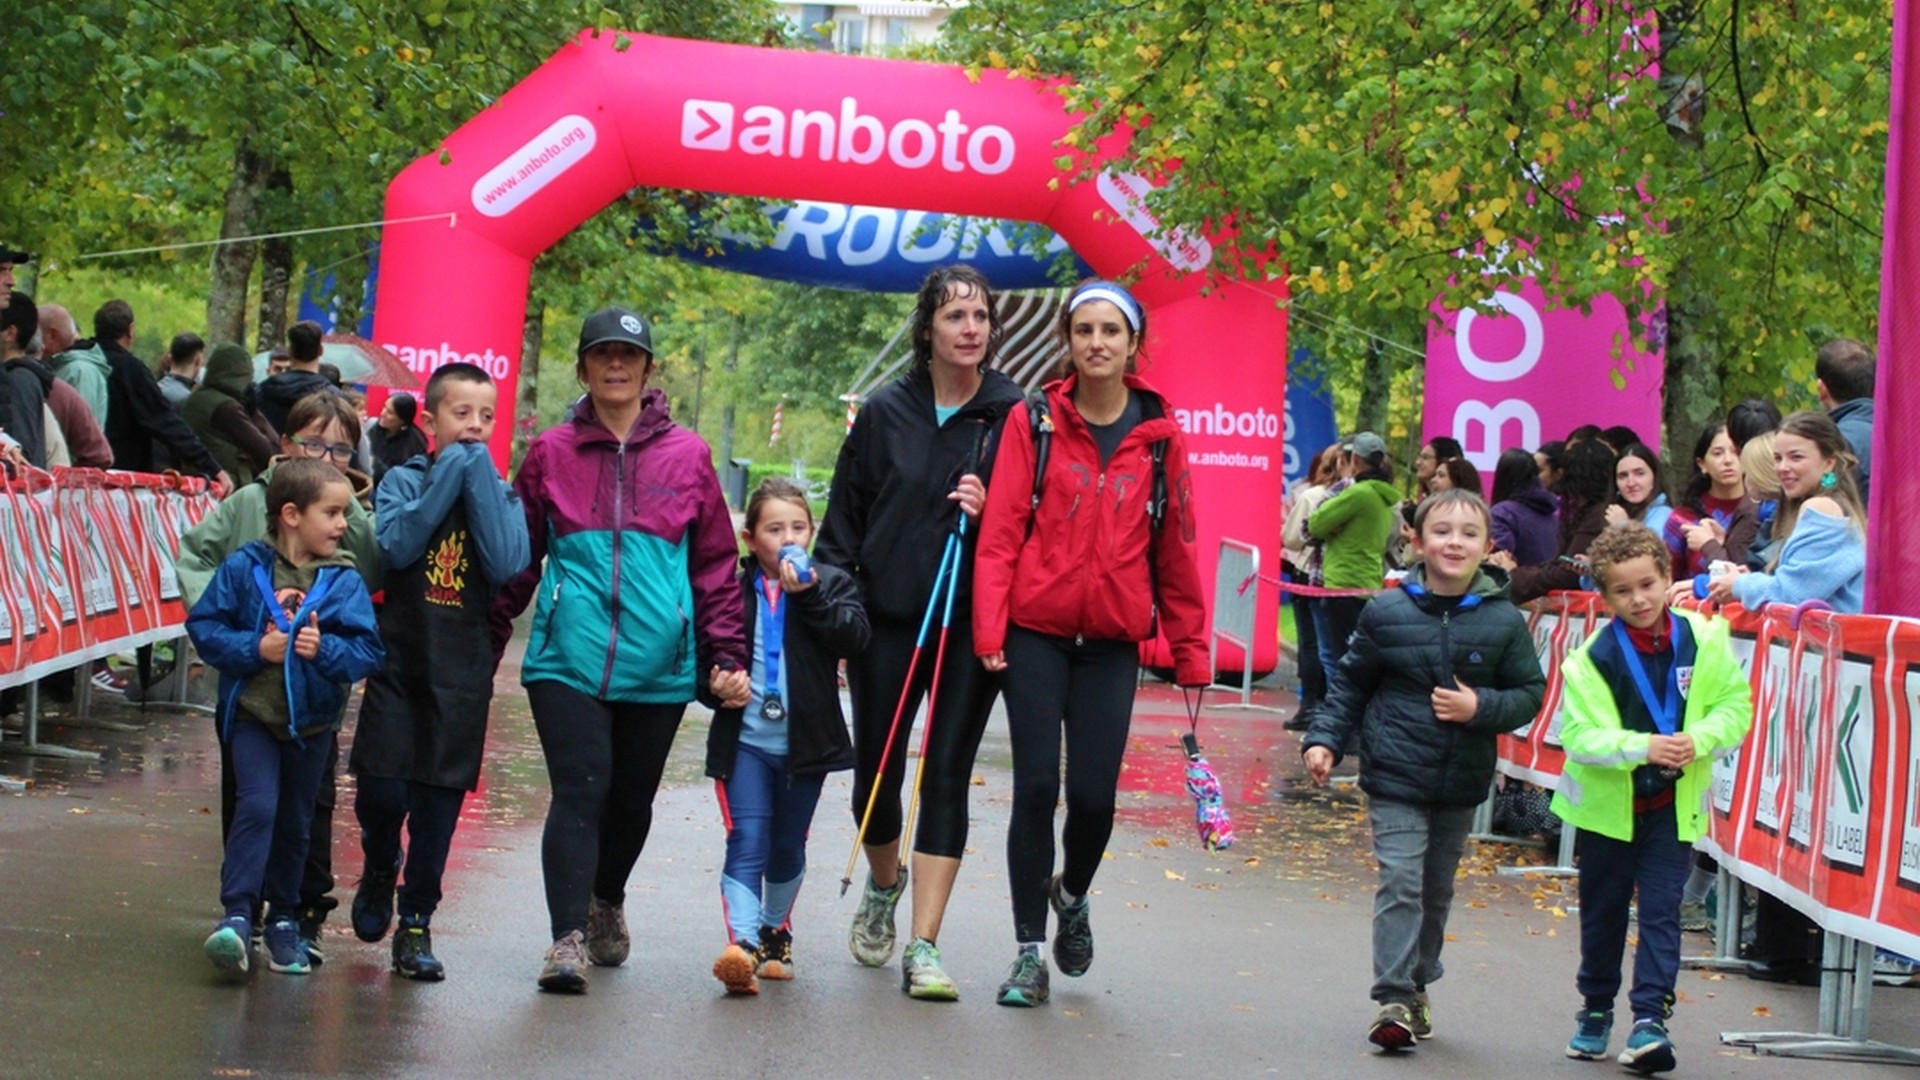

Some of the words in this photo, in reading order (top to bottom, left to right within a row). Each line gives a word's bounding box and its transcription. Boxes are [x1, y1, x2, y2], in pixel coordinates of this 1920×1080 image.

[738, 96, 1016, 175] anboto
[482, 127, 586, 205] www.anboto.org
[1174, 402, 1279, 439] anboto
[1187, 450, 1270, 472] w.anboto.org
